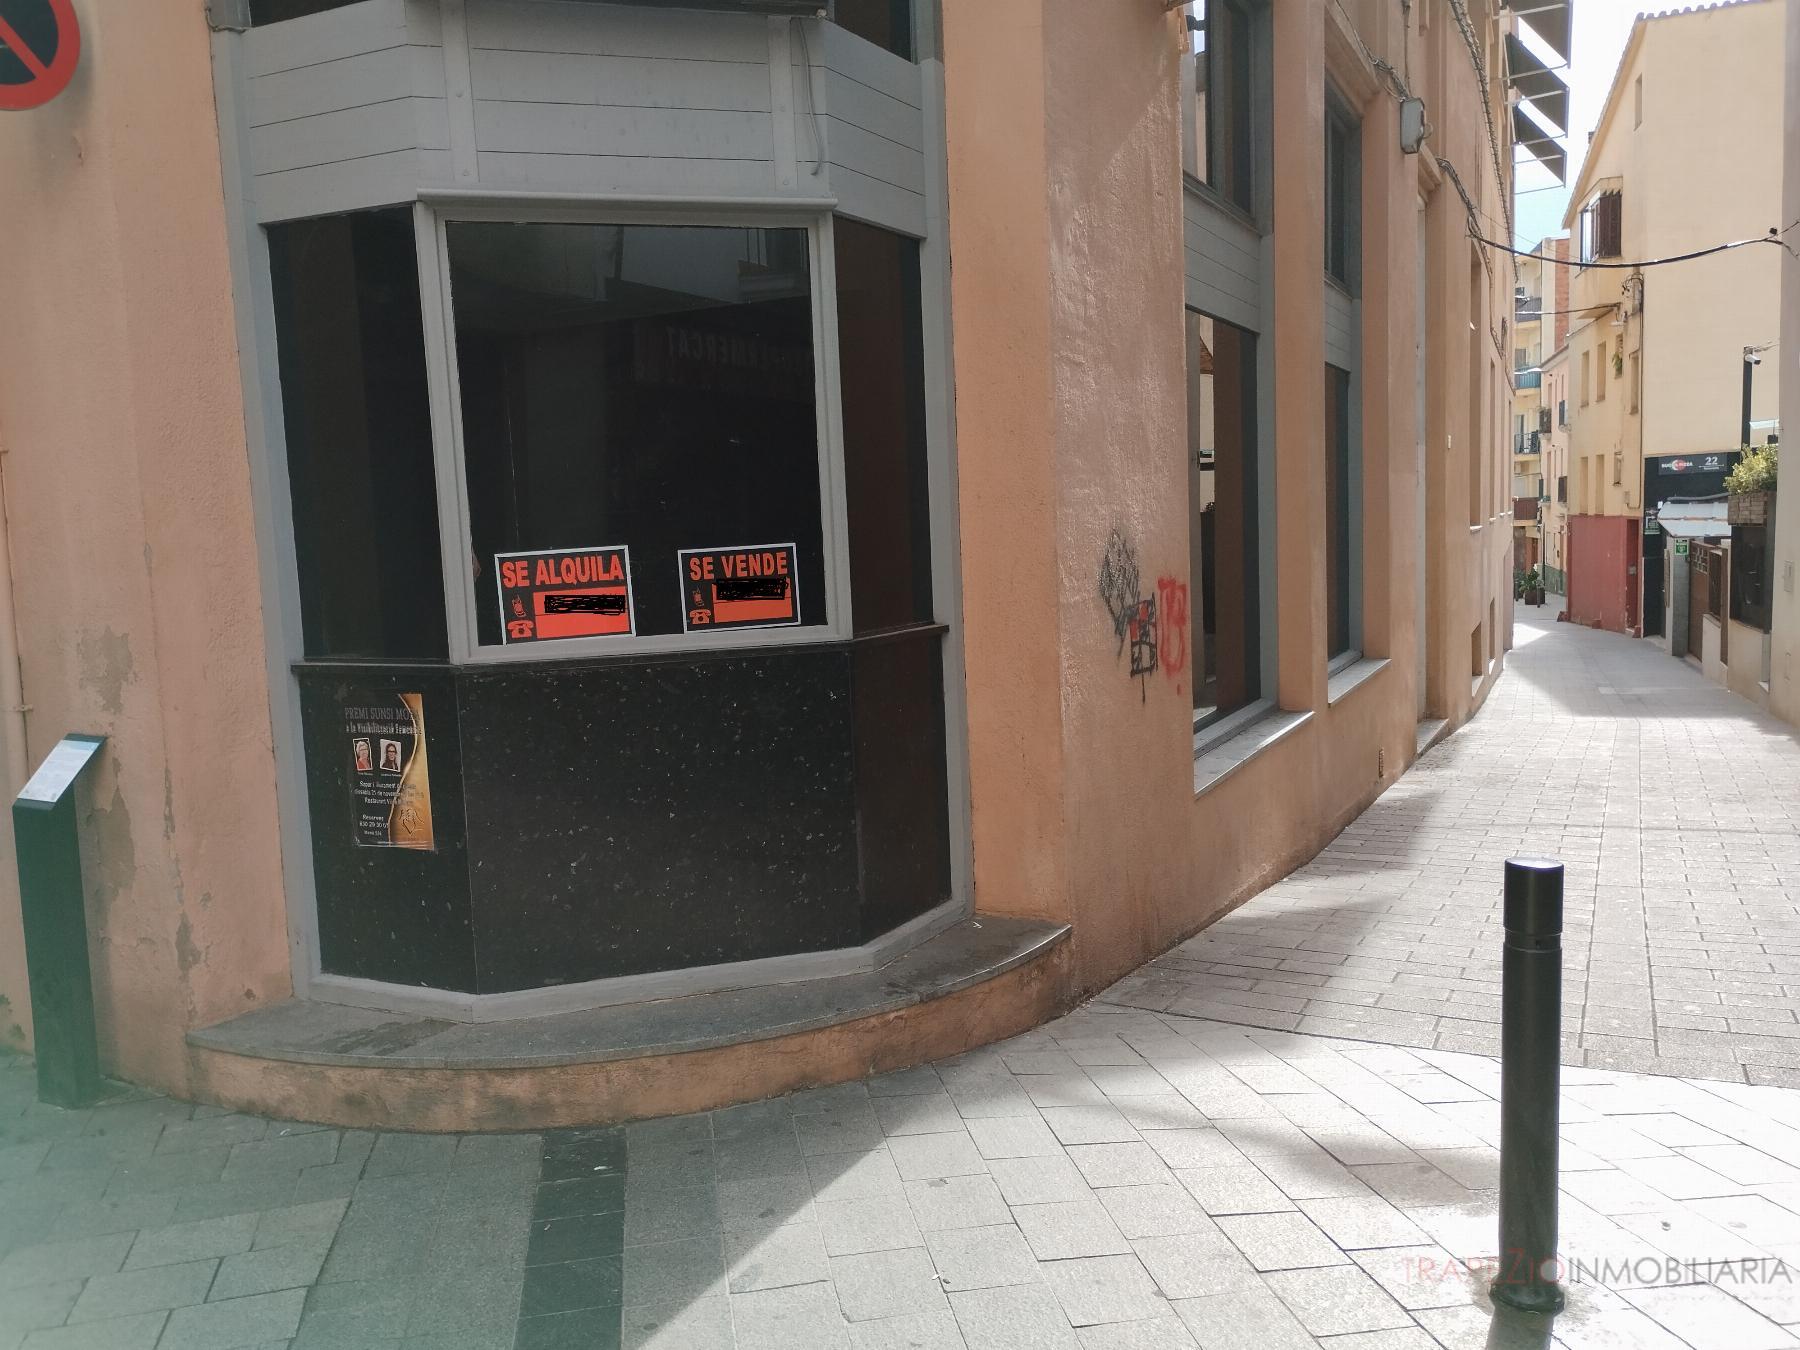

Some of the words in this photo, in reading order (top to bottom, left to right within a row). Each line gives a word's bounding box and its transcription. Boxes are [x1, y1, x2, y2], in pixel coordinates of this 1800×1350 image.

[1705, 456, 1718, 465] 22
[502, 560, 530, 588] SE
[535, 553, 625, 586] ALQUILA
[689, 556, 715, 581] SE
[720, 551, 788, 578] VENDE
[344, 707, 369, 720] PREMI
[370, 707, 393, 720] SUNSI
